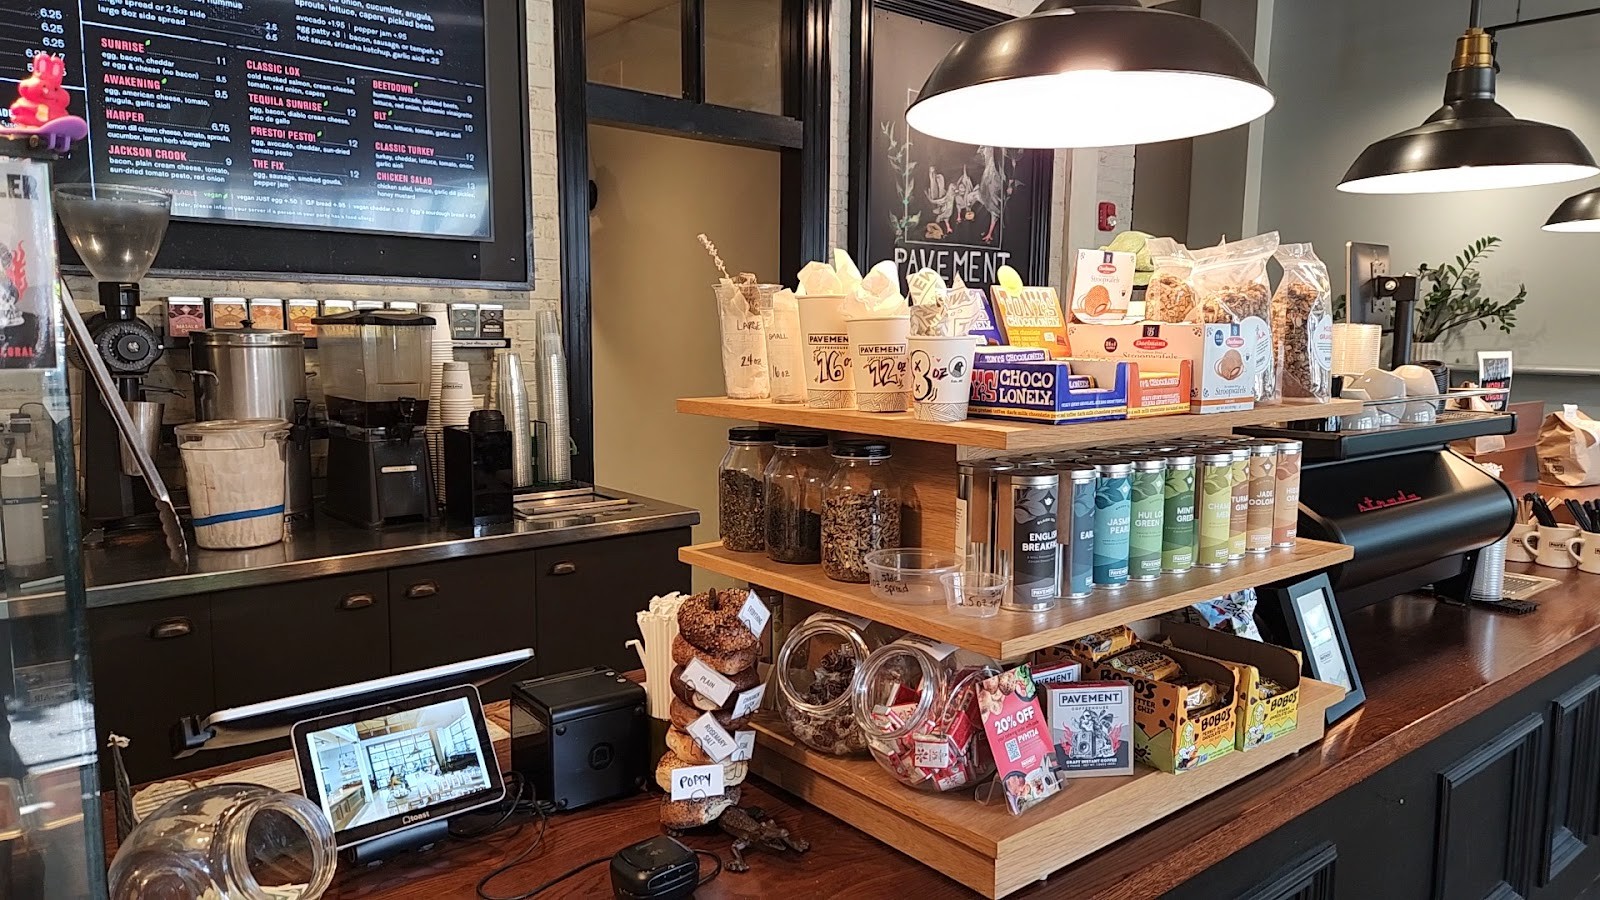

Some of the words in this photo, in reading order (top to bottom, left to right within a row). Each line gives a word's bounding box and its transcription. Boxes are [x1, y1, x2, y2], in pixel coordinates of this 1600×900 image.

[40, 8, 63, 20] 6.25
[41, 22, 64, 34] 6.25
[42, 37, 65, 49] 6.25
[101, 38, 145, 52] SUNRISE
[216, 57, 226, 65] 11
[246, 61, 282, 73] CLASSIC
[284, 66, 300, 76] LOX
[346, 77, 355, 85] 14
[104, 75, 161, 89] AWAKENING
[214, 89, 228, 99] 9.5
[373, 80, 413, 93] BEETDOWN
[248, 94, 283, 106] TEQUILA
[286, 99, 322, 111] SUNRISE
[347, 109, 356, 117] 12
[106, 110, 145, 122] HARPER
[211, 122, 230, 132] 6.75
[464, 124, 473, 132] 10
[251, 127, 285, 138] PRESTO!
[287, 131, 316, 141] PESTO!
[348, 139, 358, 148] 12
[108, 146, 152, 158] JACKSON
[155, 151, 187, 161] CROOK
[225, 158, 232, 166] 9
[375, 142, 405, 153] CLASSIC
[408, 146, 434, 156] TURKEY
[465, 153, 474, 161] 12
[252, 159, 268, 169] THE
[349, 170, 359, 178] 12
[0, 174, 39, 200] ER
[377, 172, 408, 183] CHICKEN
[410, 176, 432, 185] SALAD
[894, 248, 1011, 284] PAVEMENT
[736, 319, 762, 331] LARGE
[768, 332, 789, 341] SMALL
[860, 345, 905, 355] PAVEMENT
[816, 350, 845, 384] 16
[868, 358, 899, 388] 12
[897, 361, 907, 372] oz
[911, 349, 931, 401] 8
[932, 367, 949, 380] oz
[1000, 369, 1054, 389] CHOCO
[999, 388, 1055, 406] LONELY.
[1356, 490, 1422, 513] strada
[1134, 519, 1161, 527] GREEN
[699, 675, 716, 689] PLAIN
[1062, 693, 1120, 704] PAVEMENT
[1270, 690, 1298, 712] BOBO'S
[994, 714, 1017, 735] 20%
[1015, 705, 1035, 724] OFF
[1201, 708, 1232, 732] BOBO'S
[702, 735, 716, 748] SALT
[704, 723, 728, 749] ROSEMARY
[679, 773, 712, 789] POPPY
[409, 811, 431, 823] toast
